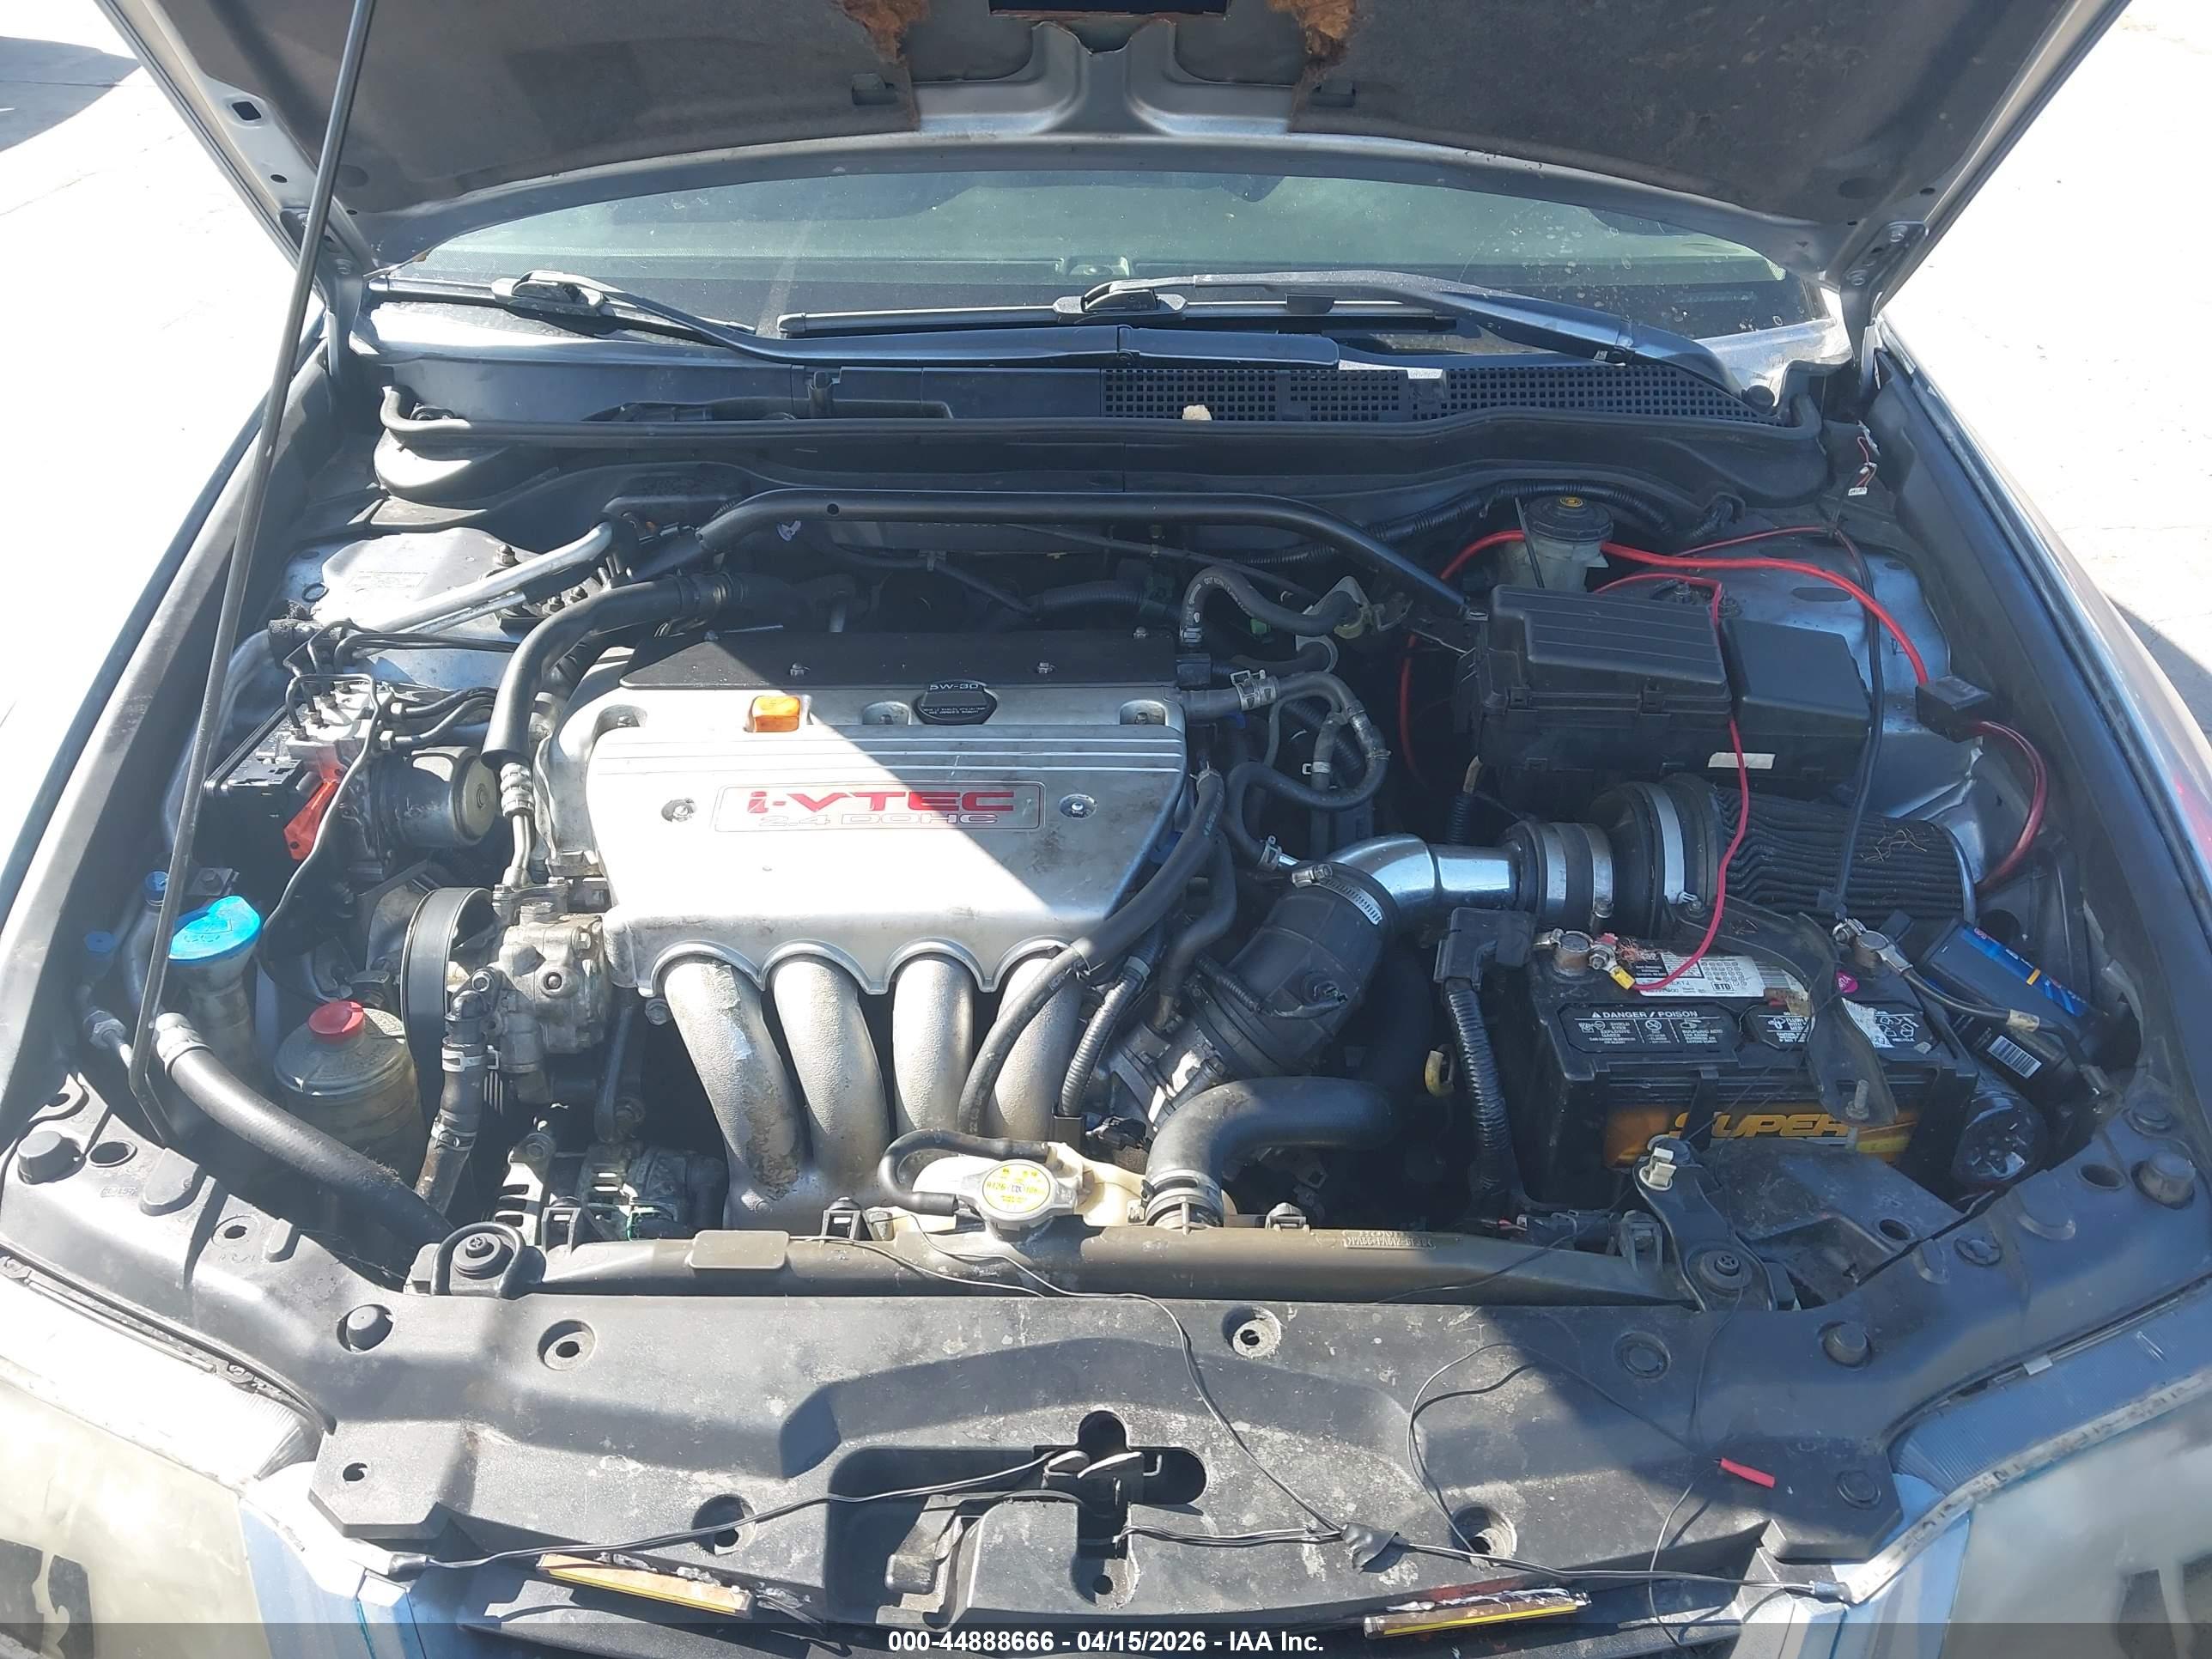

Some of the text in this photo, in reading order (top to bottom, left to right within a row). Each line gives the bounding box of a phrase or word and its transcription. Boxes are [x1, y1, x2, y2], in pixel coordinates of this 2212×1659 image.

[747, 791, 1015, 813] i-VTEC
[758, 812, 998, 827] 2.4 DOHC
